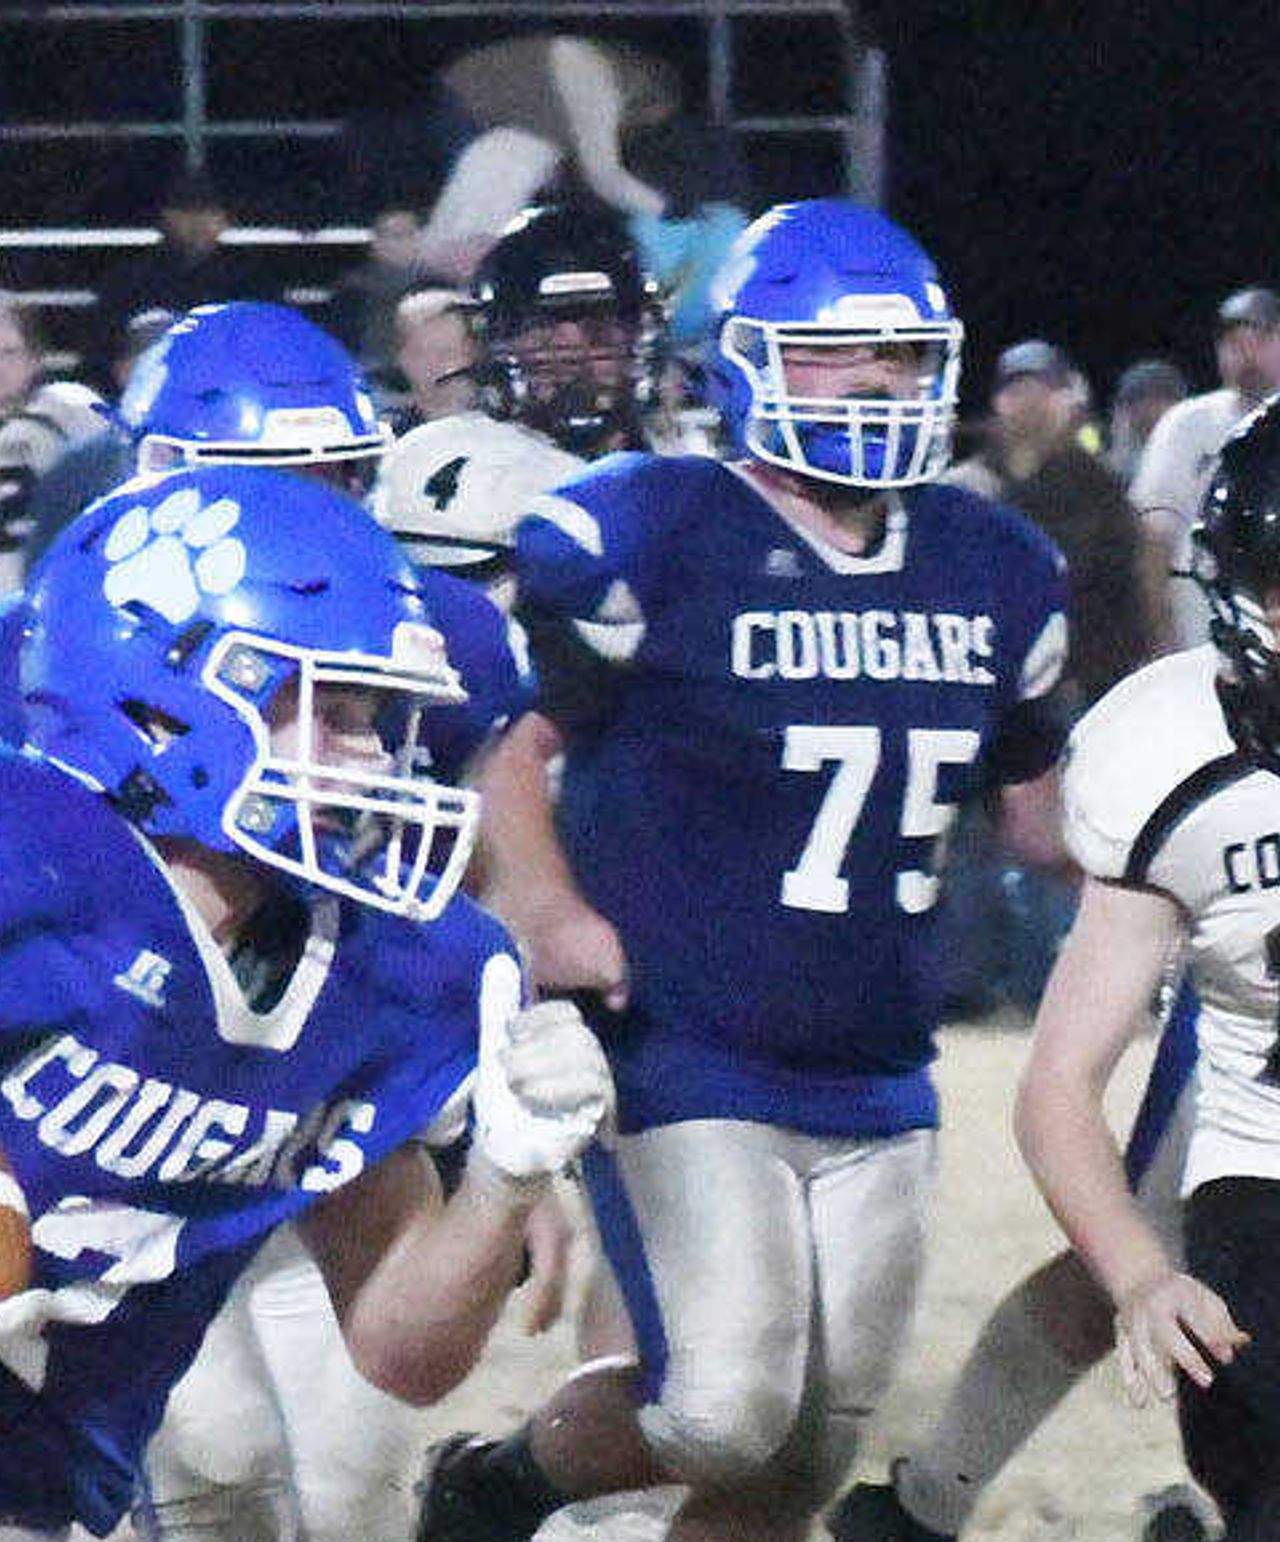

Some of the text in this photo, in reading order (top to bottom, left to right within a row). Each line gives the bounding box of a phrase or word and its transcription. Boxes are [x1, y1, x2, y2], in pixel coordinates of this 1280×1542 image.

[423, 456, 469, 511] 4
[731, 610, 997, 687] COUGARS
[780, 725, 981, 915] 75
